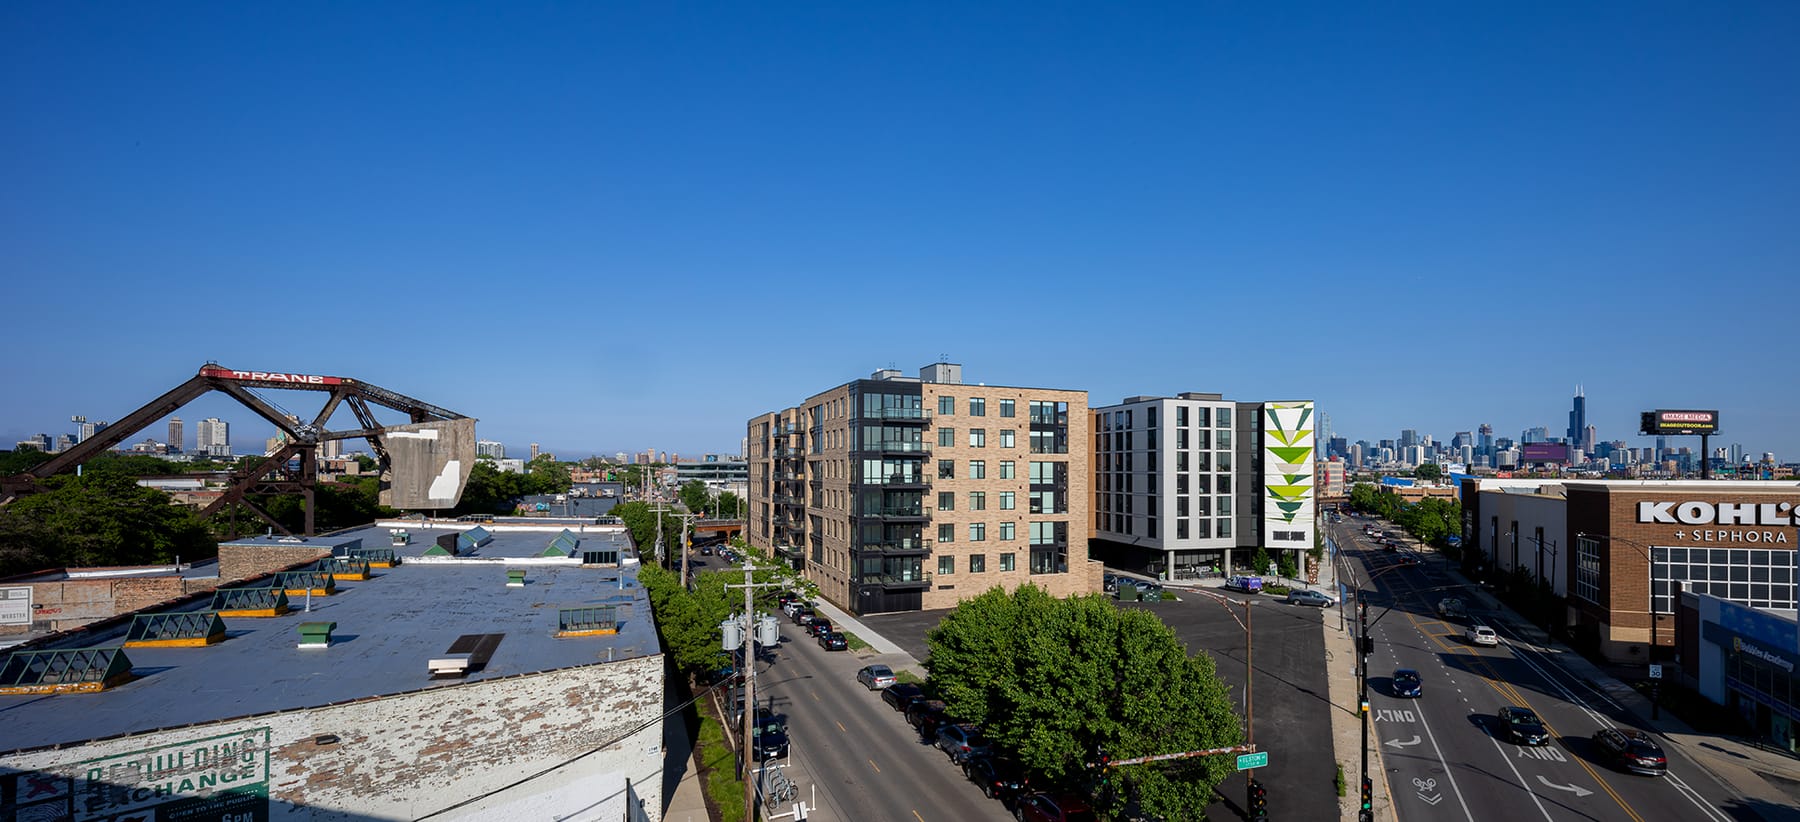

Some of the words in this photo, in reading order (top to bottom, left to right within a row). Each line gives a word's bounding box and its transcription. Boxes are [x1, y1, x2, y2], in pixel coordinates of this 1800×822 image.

[1692, 529, 1788, 544] SEPHORA
[1375, 709, 1416, 723] ONLY
[1516, 745, 1568, 763] ONLY
[84, 764, 256, 813] EXCHANGE
[196, 805, 207, 813] TO
[209, 801, 225, 810] THE
[226, 794, 256, 806] PUBLIC
